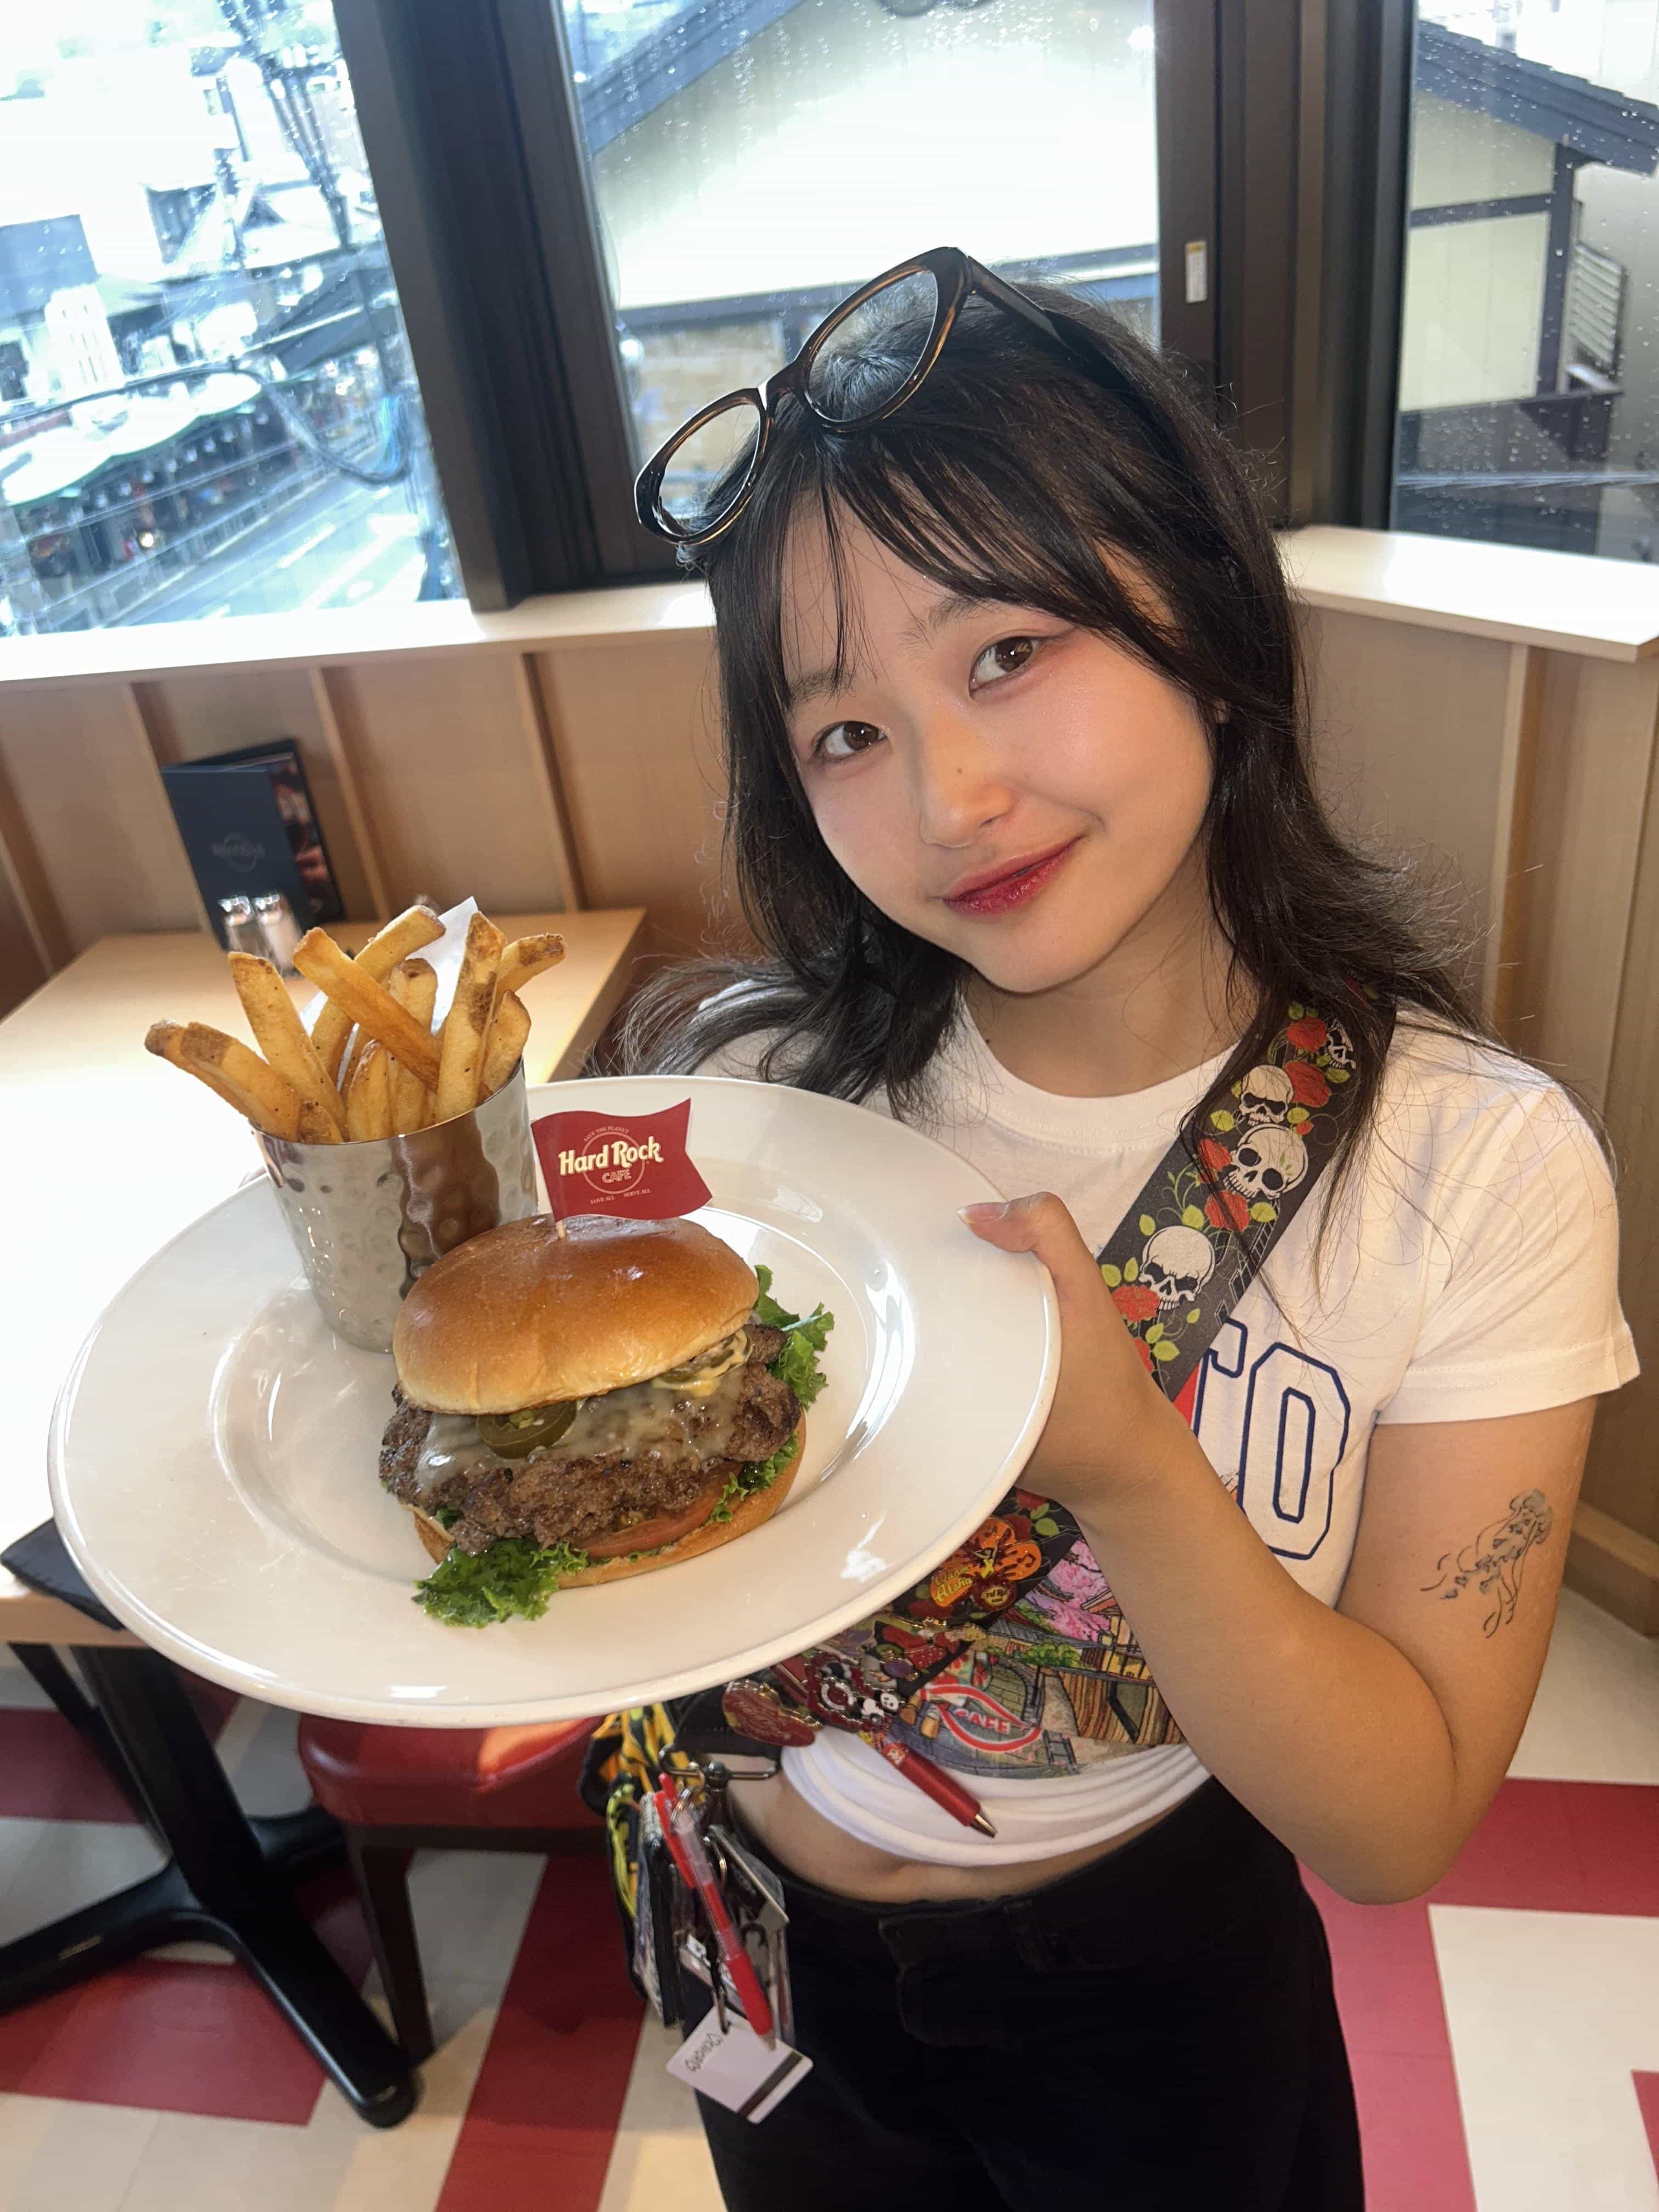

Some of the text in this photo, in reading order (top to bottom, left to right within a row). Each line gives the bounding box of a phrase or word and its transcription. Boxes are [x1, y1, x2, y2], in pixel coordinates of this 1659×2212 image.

[607, 1126, 629, 1135] PLANET
[558, 1136, 664, 1176] Hard Rock
[602, 1169, 632, 1183] CAFE
